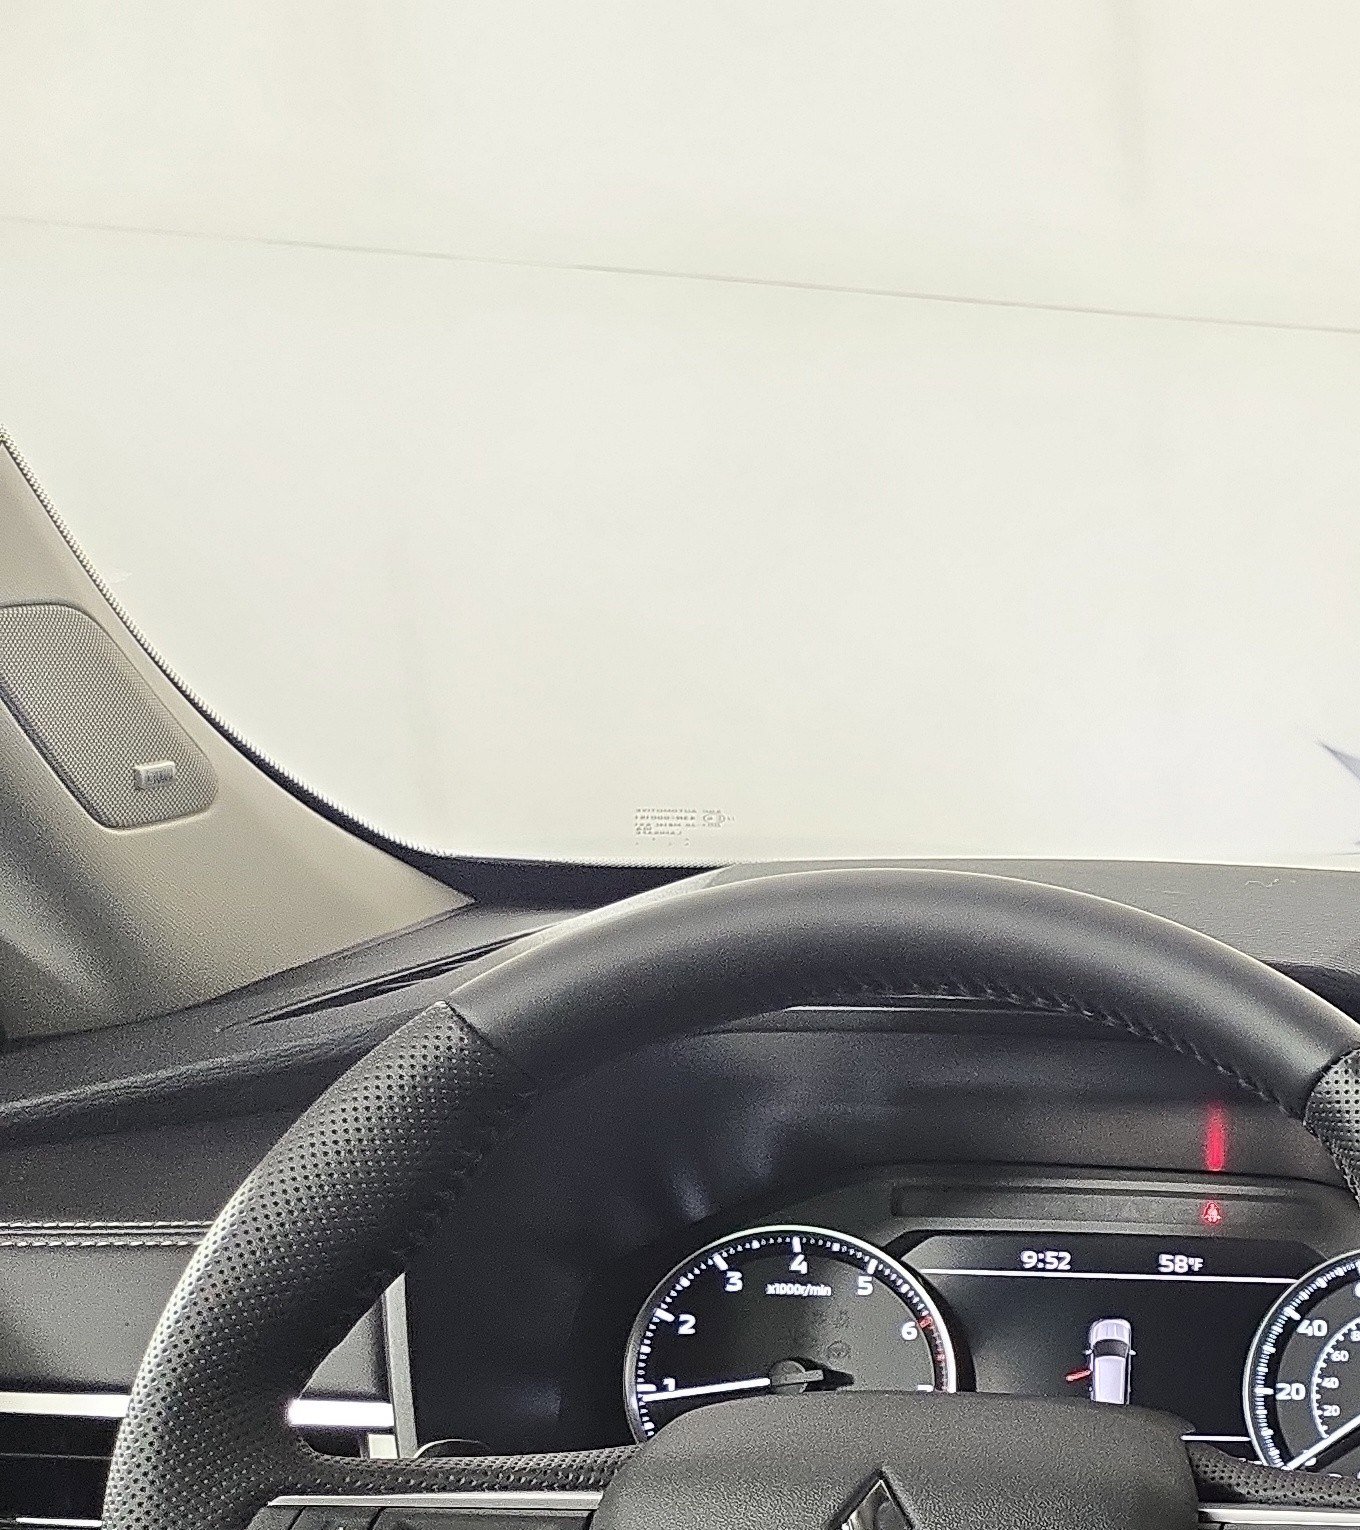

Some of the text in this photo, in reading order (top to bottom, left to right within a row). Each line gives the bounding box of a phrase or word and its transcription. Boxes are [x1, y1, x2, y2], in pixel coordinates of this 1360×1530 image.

[789, 1254, 809, 1275] 4
[1020, 1251, 1072, 1270] 9:52
[724, 1271, 743, 1292] 3
[857, 1276, 874, 1296] 5
[677, 1314, 696, 1335] 2
[901, 1322, 918, 1341] 6
[1297, 1318, 1328, 1337] 40
[1276, 1382, 1306, 1401] 20
